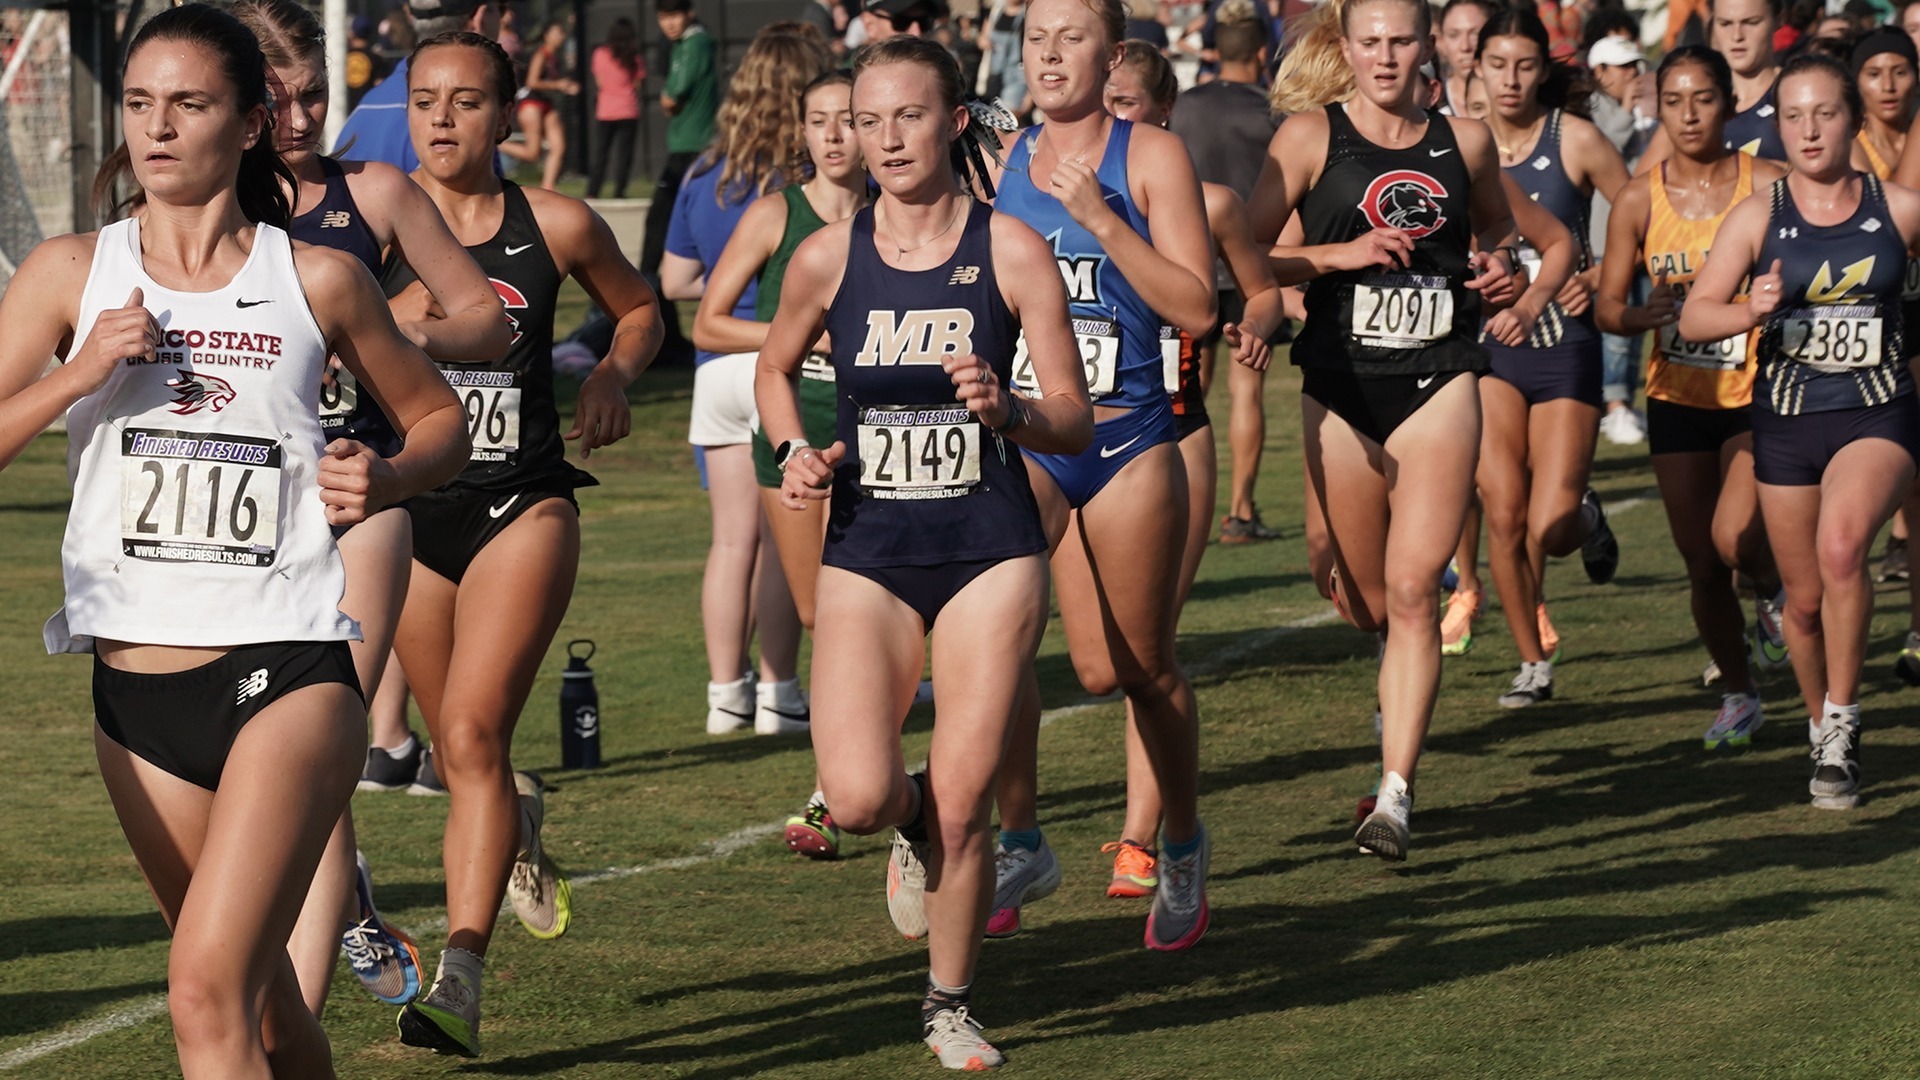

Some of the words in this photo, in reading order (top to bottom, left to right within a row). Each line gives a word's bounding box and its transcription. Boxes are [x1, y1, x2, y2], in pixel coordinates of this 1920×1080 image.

[1365, 288, 1438, 335] 2091
[209, 330, 282, 357] STATE
[854, 307, 975, 366] MB
[1794, 320, 1869, 363] 2385
[193, 352, 277, 371] COUNTRY
[462, 370, 514, 387] RESULTS
[864, 407, 917, 425] FINISHED
[915, 408, 970, 425] RESULTS
[130, 432, 199, 459] FINISHED
[196, 439, 270, 464] RESULTS
[875, 426, 966, 482] 2149
[136, 460, 257, 542] 2116
[134, 545, 257, 566] WWW.FINISHEDRESULTS.COM
